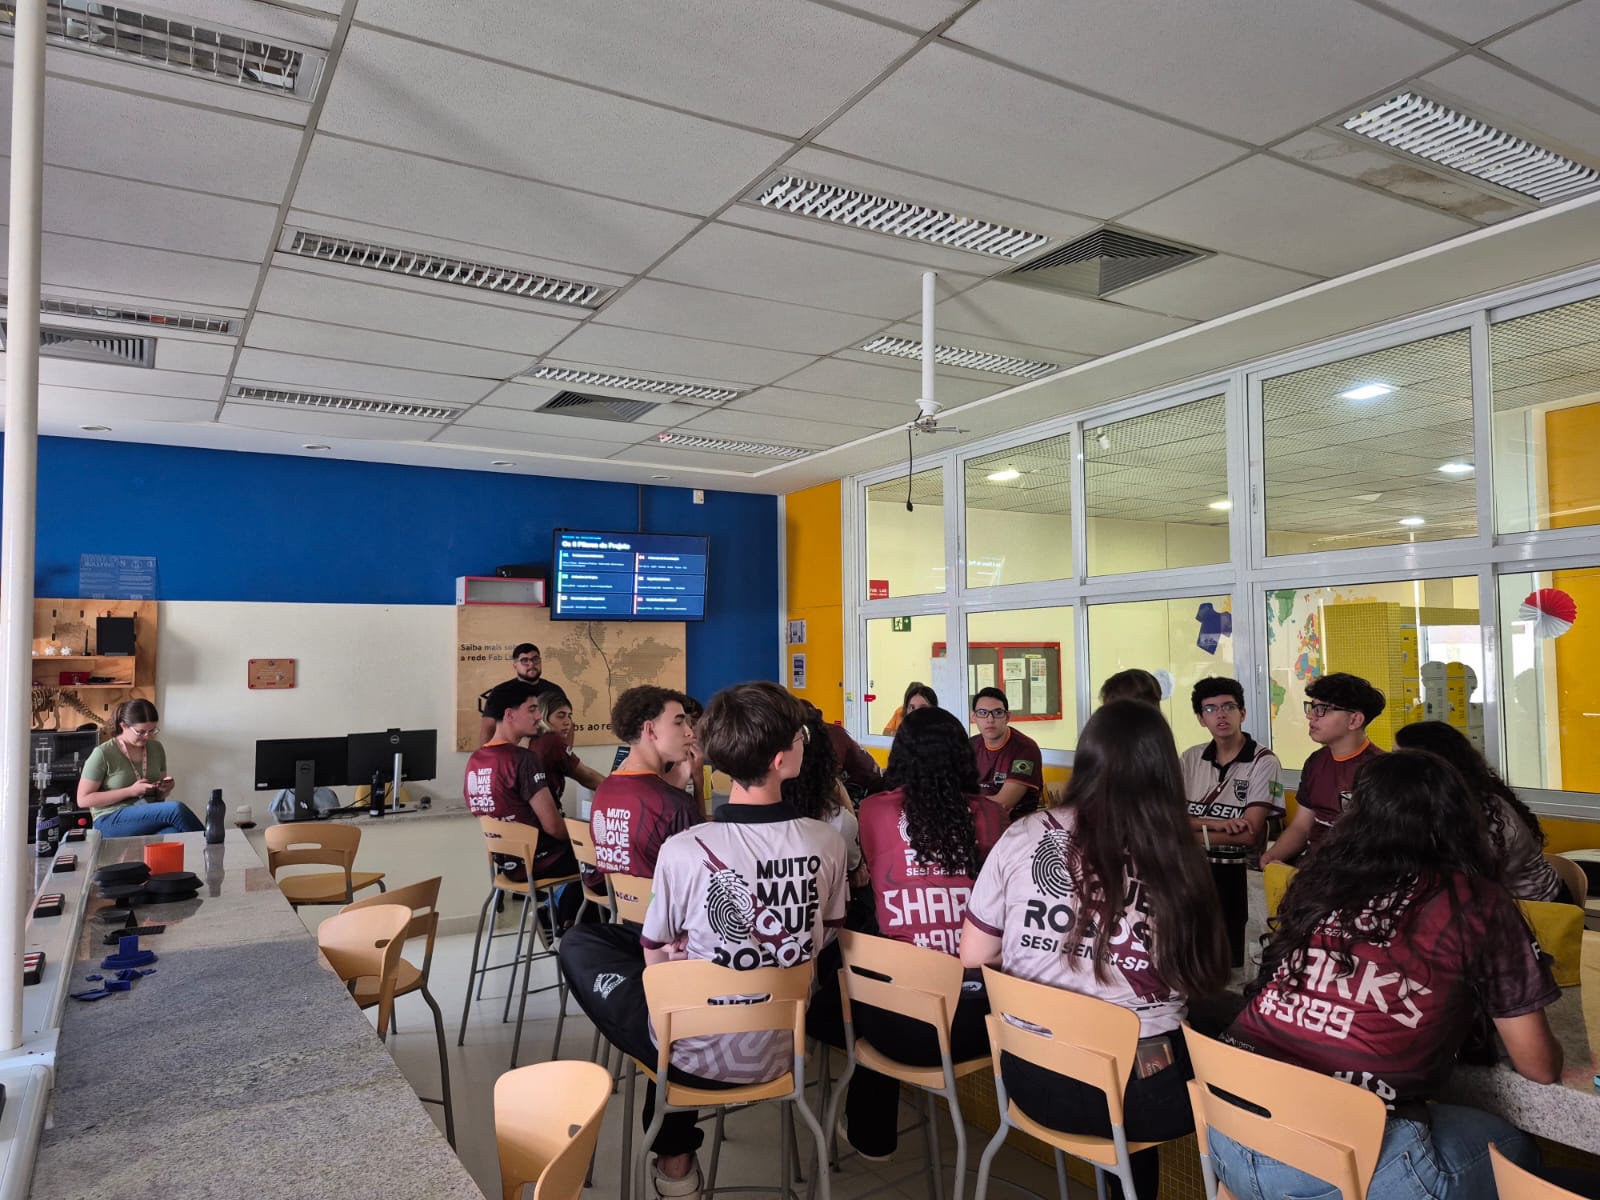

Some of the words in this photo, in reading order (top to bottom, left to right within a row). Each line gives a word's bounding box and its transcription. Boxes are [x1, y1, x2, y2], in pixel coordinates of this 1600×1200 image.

[587, 723, 600, 731] ao
[477, 785, 492, 795] QUE
[607, 808, 631, 820] MUITO
[1188, 803, 1207, 816] ESI
[1211, 804, 1242, 819] SEN
[606, 818, 629, 833] MAIS
[606, 831, 630, 848] QUE
[757, 855, 821, 880] MUITO
[757, 877, 819, 907] MAIS
[882, 887, 971, 927] SHAR
[755, 902, 819, 936] QUE
[1020, 934, 1060, 953] SESI
[1062, 942, 1150, 972] SENI-SP
[1272, 947, 1433, 1030] ARKS
